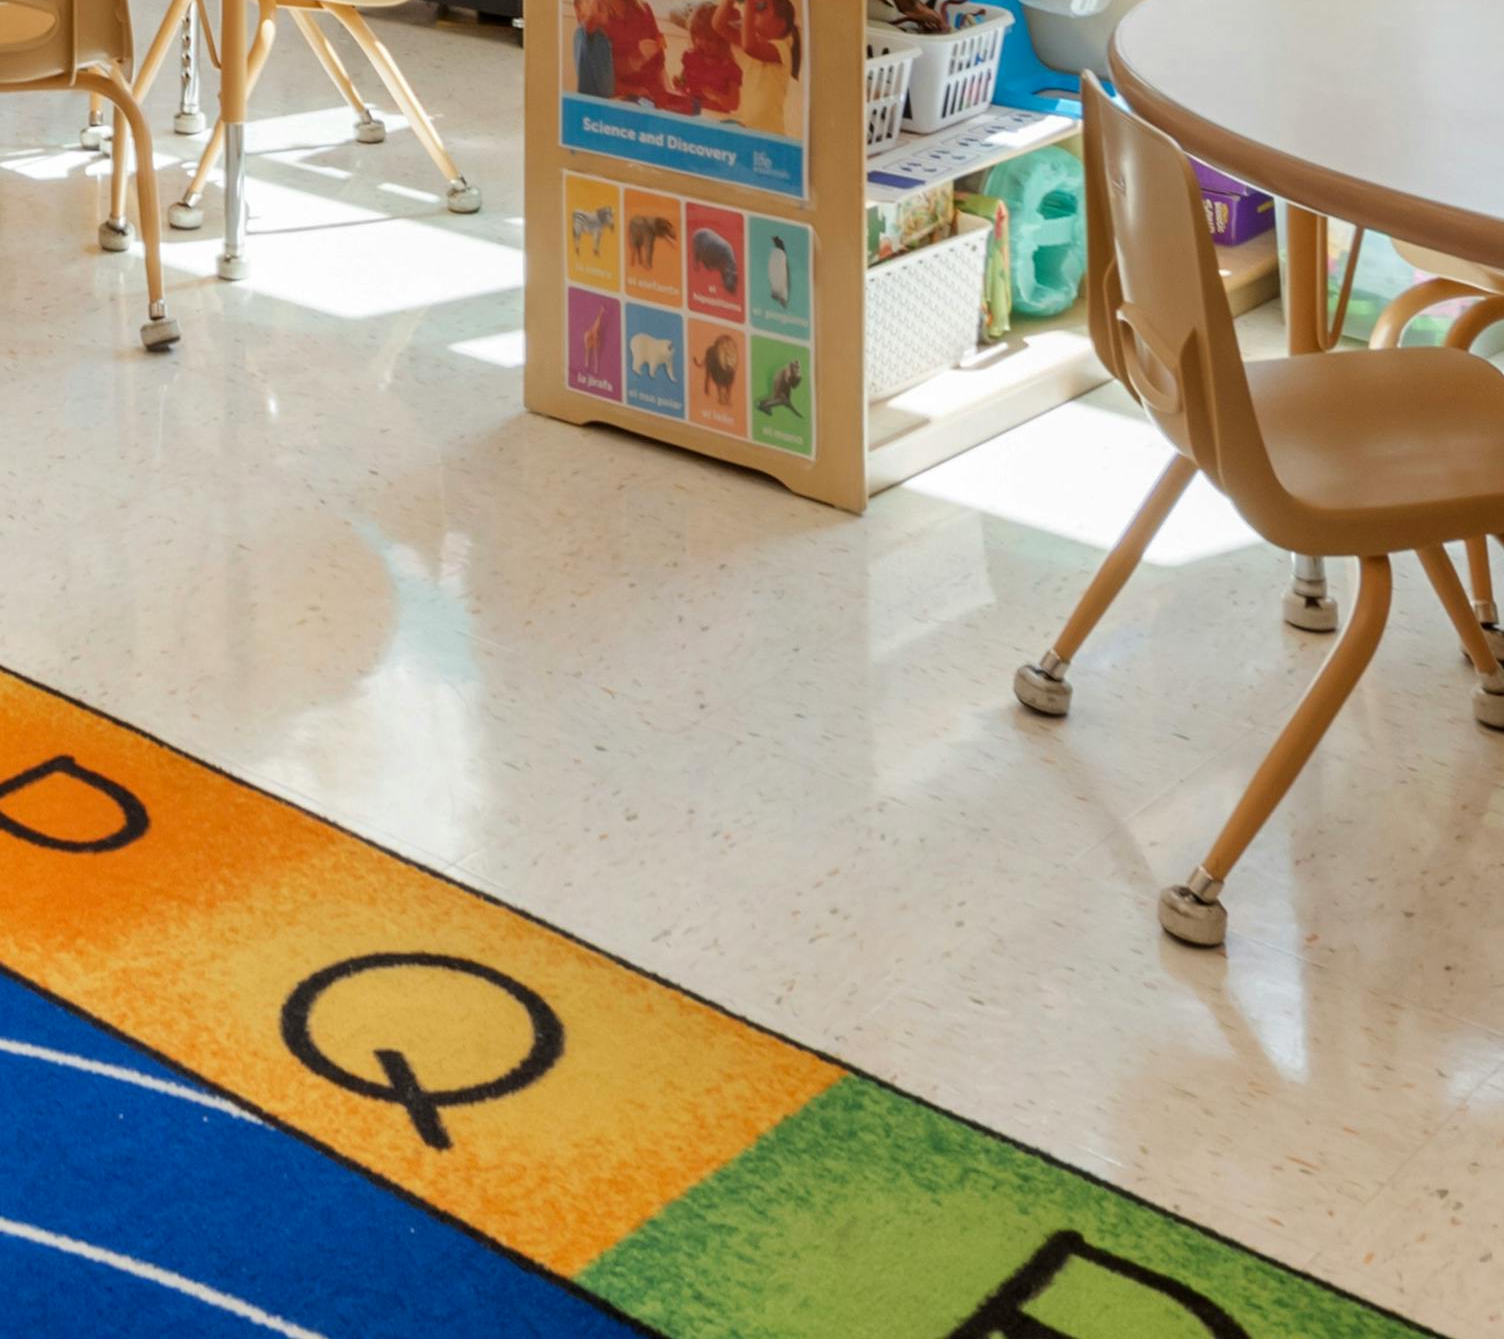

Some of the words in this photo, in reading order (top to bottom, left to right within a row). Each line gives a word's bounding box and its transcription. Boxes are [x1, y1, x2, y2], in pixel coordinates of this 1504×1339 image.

[583, 116, 636, 143] Science
[639, 131, 665, 148] and
[668, 137, 737, 166] Discovery
[753, 151, 772, 169] life
[638, 279, 679, 295] elefante
[576, 372, 586, 383] la
[587, 376, 613, 392] jirafa
[280, 952, 564, 1148] Q
